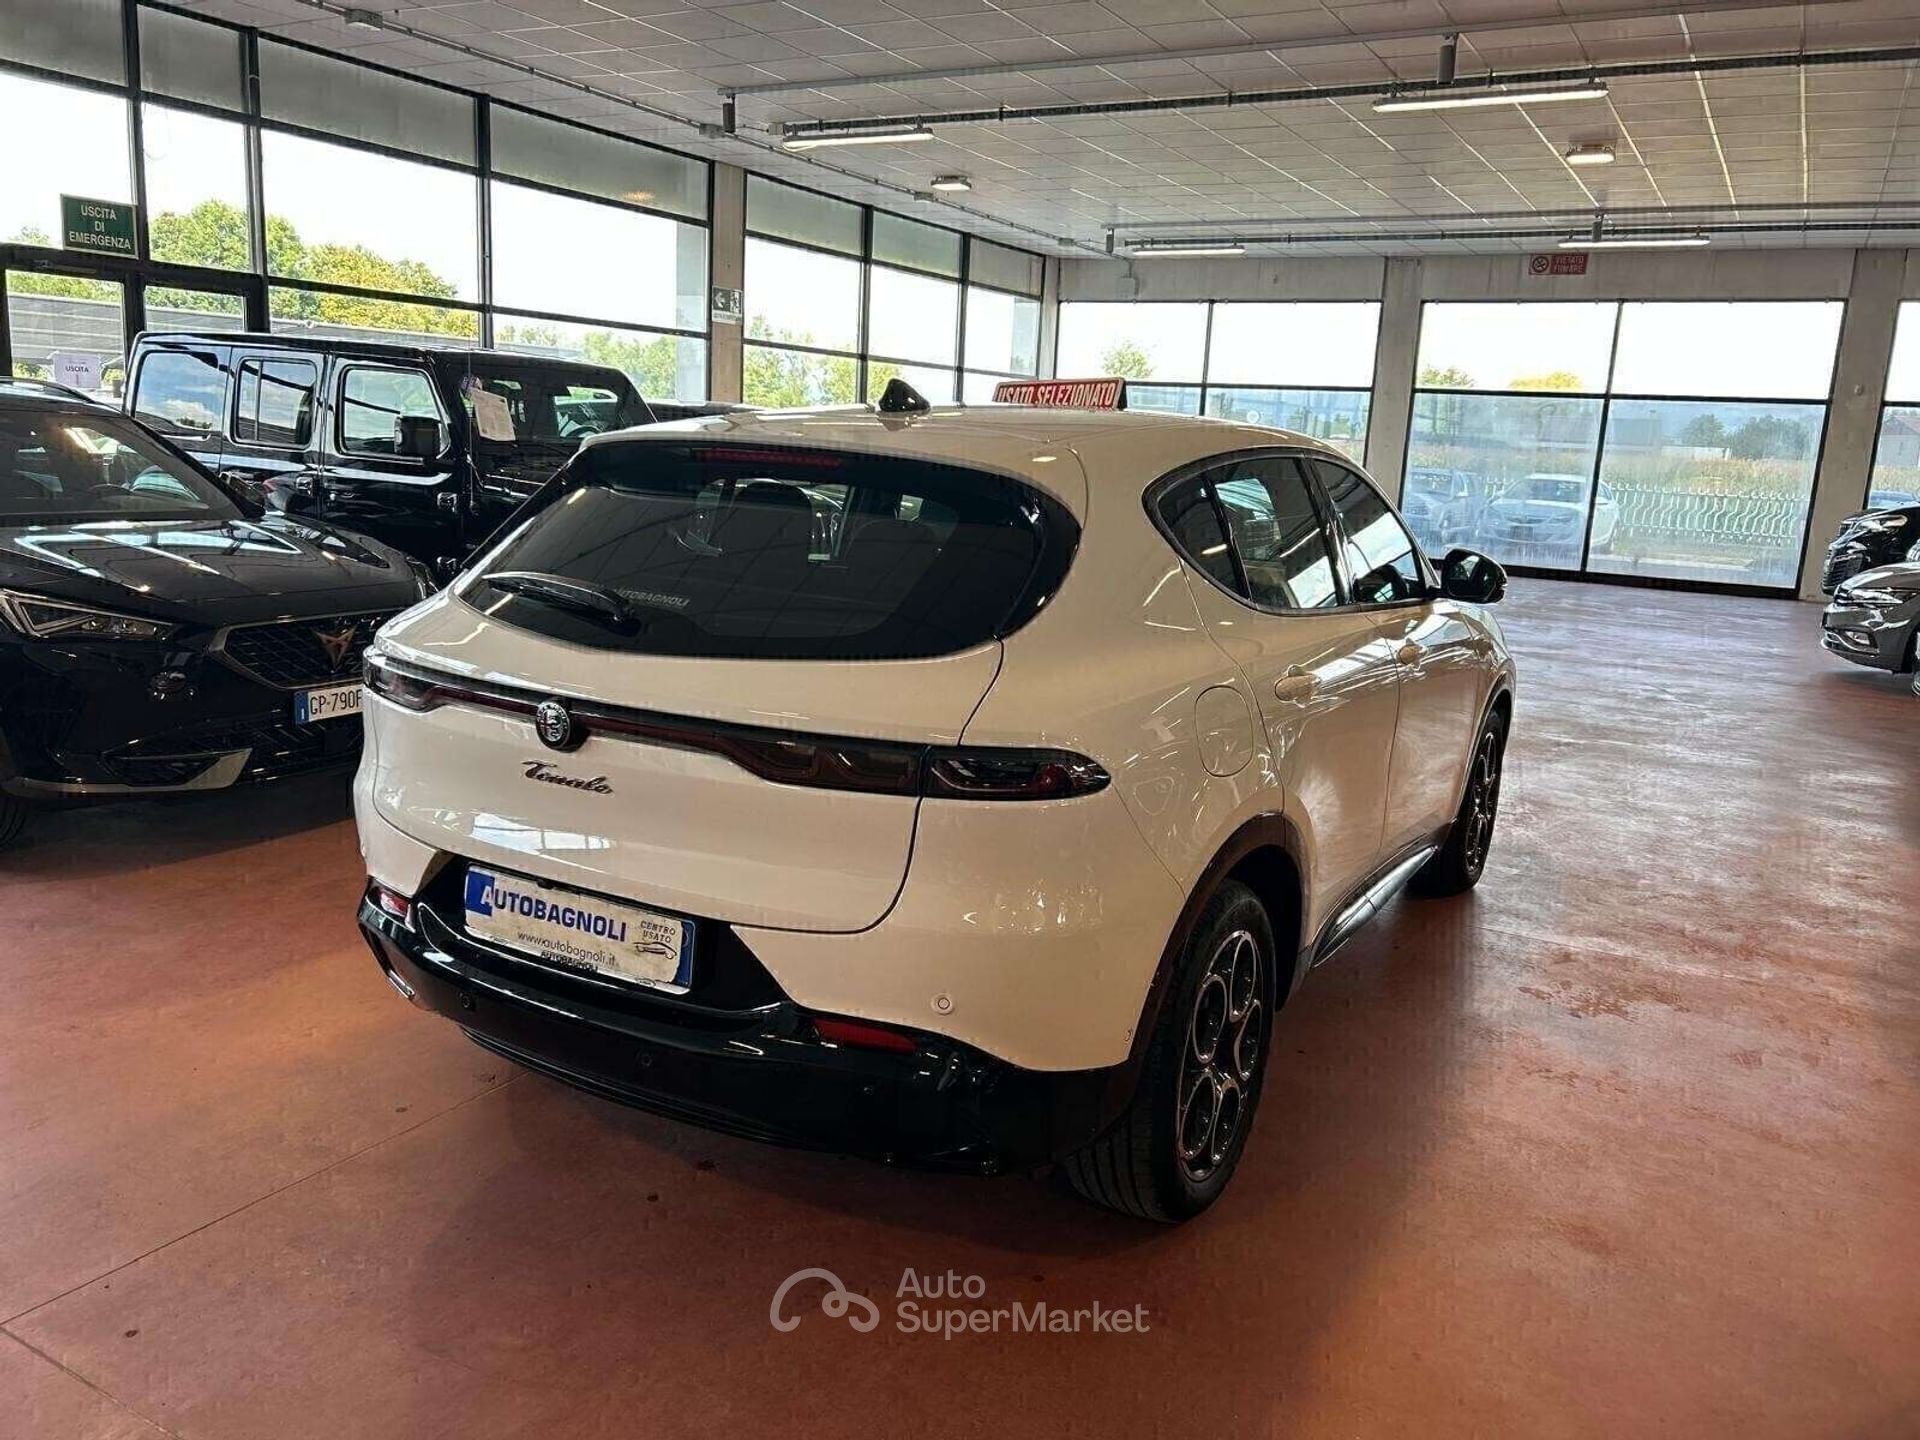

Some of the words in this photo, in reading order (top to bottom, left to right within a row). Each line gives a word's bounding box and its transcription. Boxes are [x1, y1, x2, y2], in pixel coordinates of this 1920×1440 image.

[80, 204, 117, 221] USCITA
[94, 220, 105, 232] DI
[68, 230, 132, 250] EMERGENZA
[65, 365, 89, 373] USCITA
[997, 385, 1035, 405] USATO
[1036, 382, 1117, 407] SELEZIONATO
[480, 884, 627, 943] AUTOBAGNOLI
[641, 920, 676, 936] CENTRO
[643, 930, 672, 944] USATO
[518, 931, 618, 968] www.autobagnoli.it
